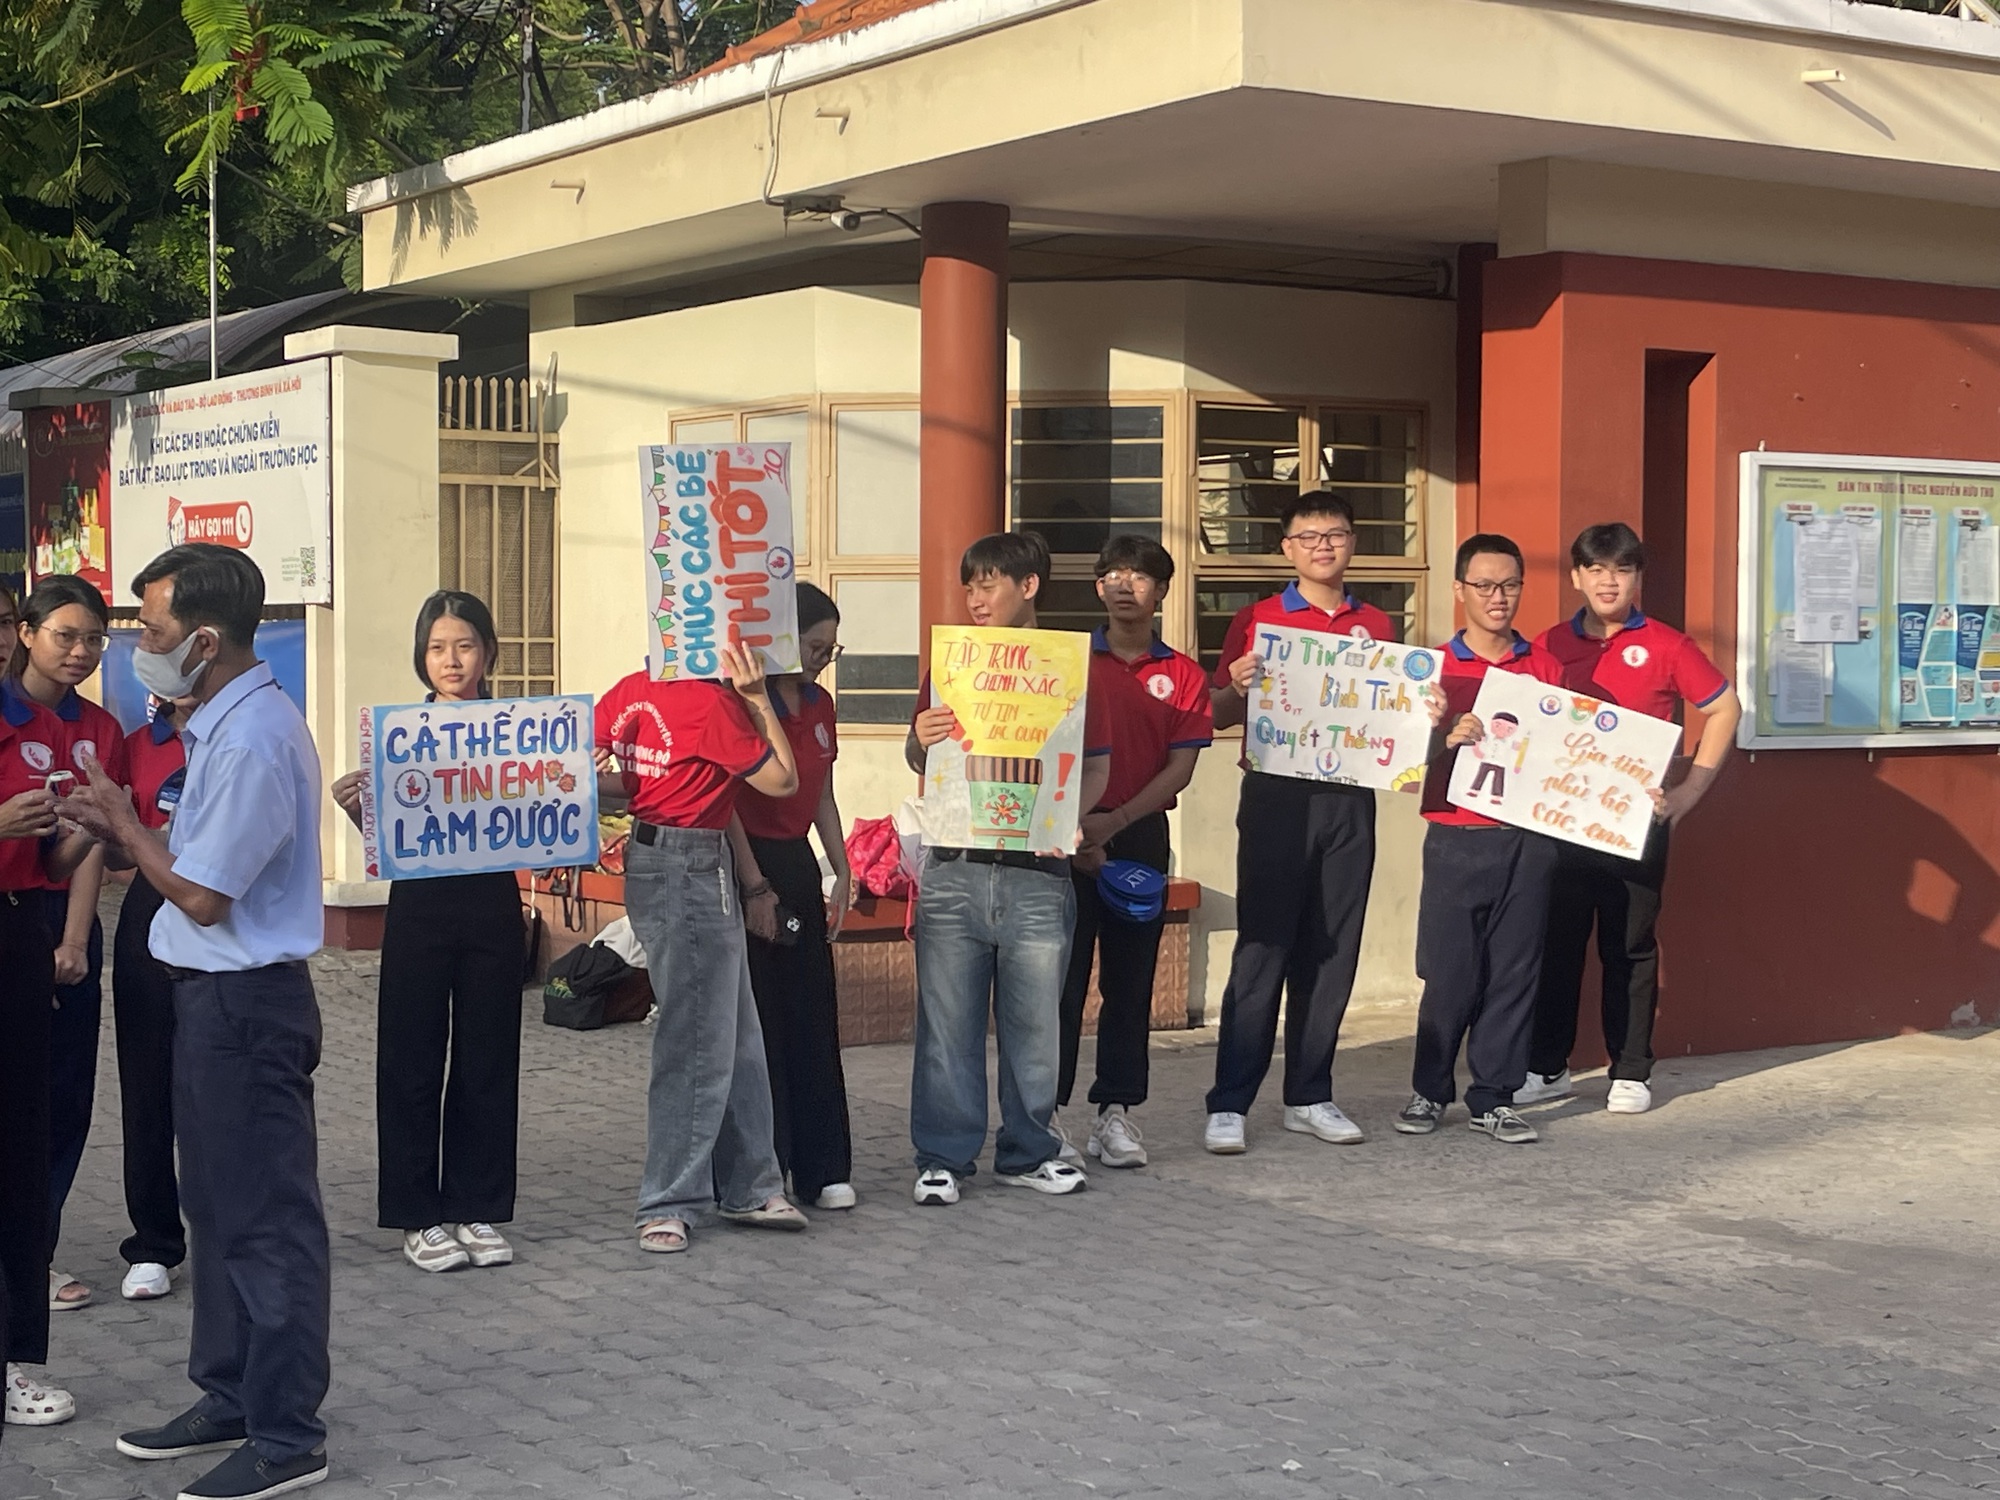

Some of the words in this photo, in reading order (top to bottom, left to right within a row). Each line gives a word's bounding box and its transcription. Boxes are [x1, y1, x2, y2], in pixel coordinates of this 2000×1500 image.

[150, 437, 163, 455] KHI
[165, 430, 180, 454] CÁC
[182, 433, 194, 451] EM
[204, 423, 227, 453] HOẶC
[228, 419, 258, 445] CHỨNG
[259, 410, 280, 440] KIẾN
[155, 464, 171, 489] BẠO
[190, 458, 216, 479] TRONG
[218, 452, 230, 476] VÀ
[231, 448, 257, 474] NGOÀI
[259, 443, 296, 470] TRƯỜNG
[297, 443, 318, 471] HỌC
[666, 450, 707, 498] BÉ
[763, 448, 783, 484] 10
[188, 515, 206, 538] HÃY
[207, 518, 221, 542] GỌI
[222, 517, 234, 535] 111
[707, 449, 768, 570] TỐT
[670, 503, 712, 575] CÁC
[673, 580, 718, 676] CHÚC
[713, 571, 773, 660] THI
[986, 643, 1032, 671] TRUNG
[386, 712, 440, 764] CẢ
[439, 704, 514, 760] THẾ
[516, 703, 578, 754] GIỚI
[996, 703, 1020, 722] TIN
[1015, 726, 1048, 743] QUAN
[433, 761, 493, 804] TIN
[500, 759, 545, 800] EM
[395, 804, 477, 859] LÀM
[483, 798, 581, 855] ĐƯỢC
